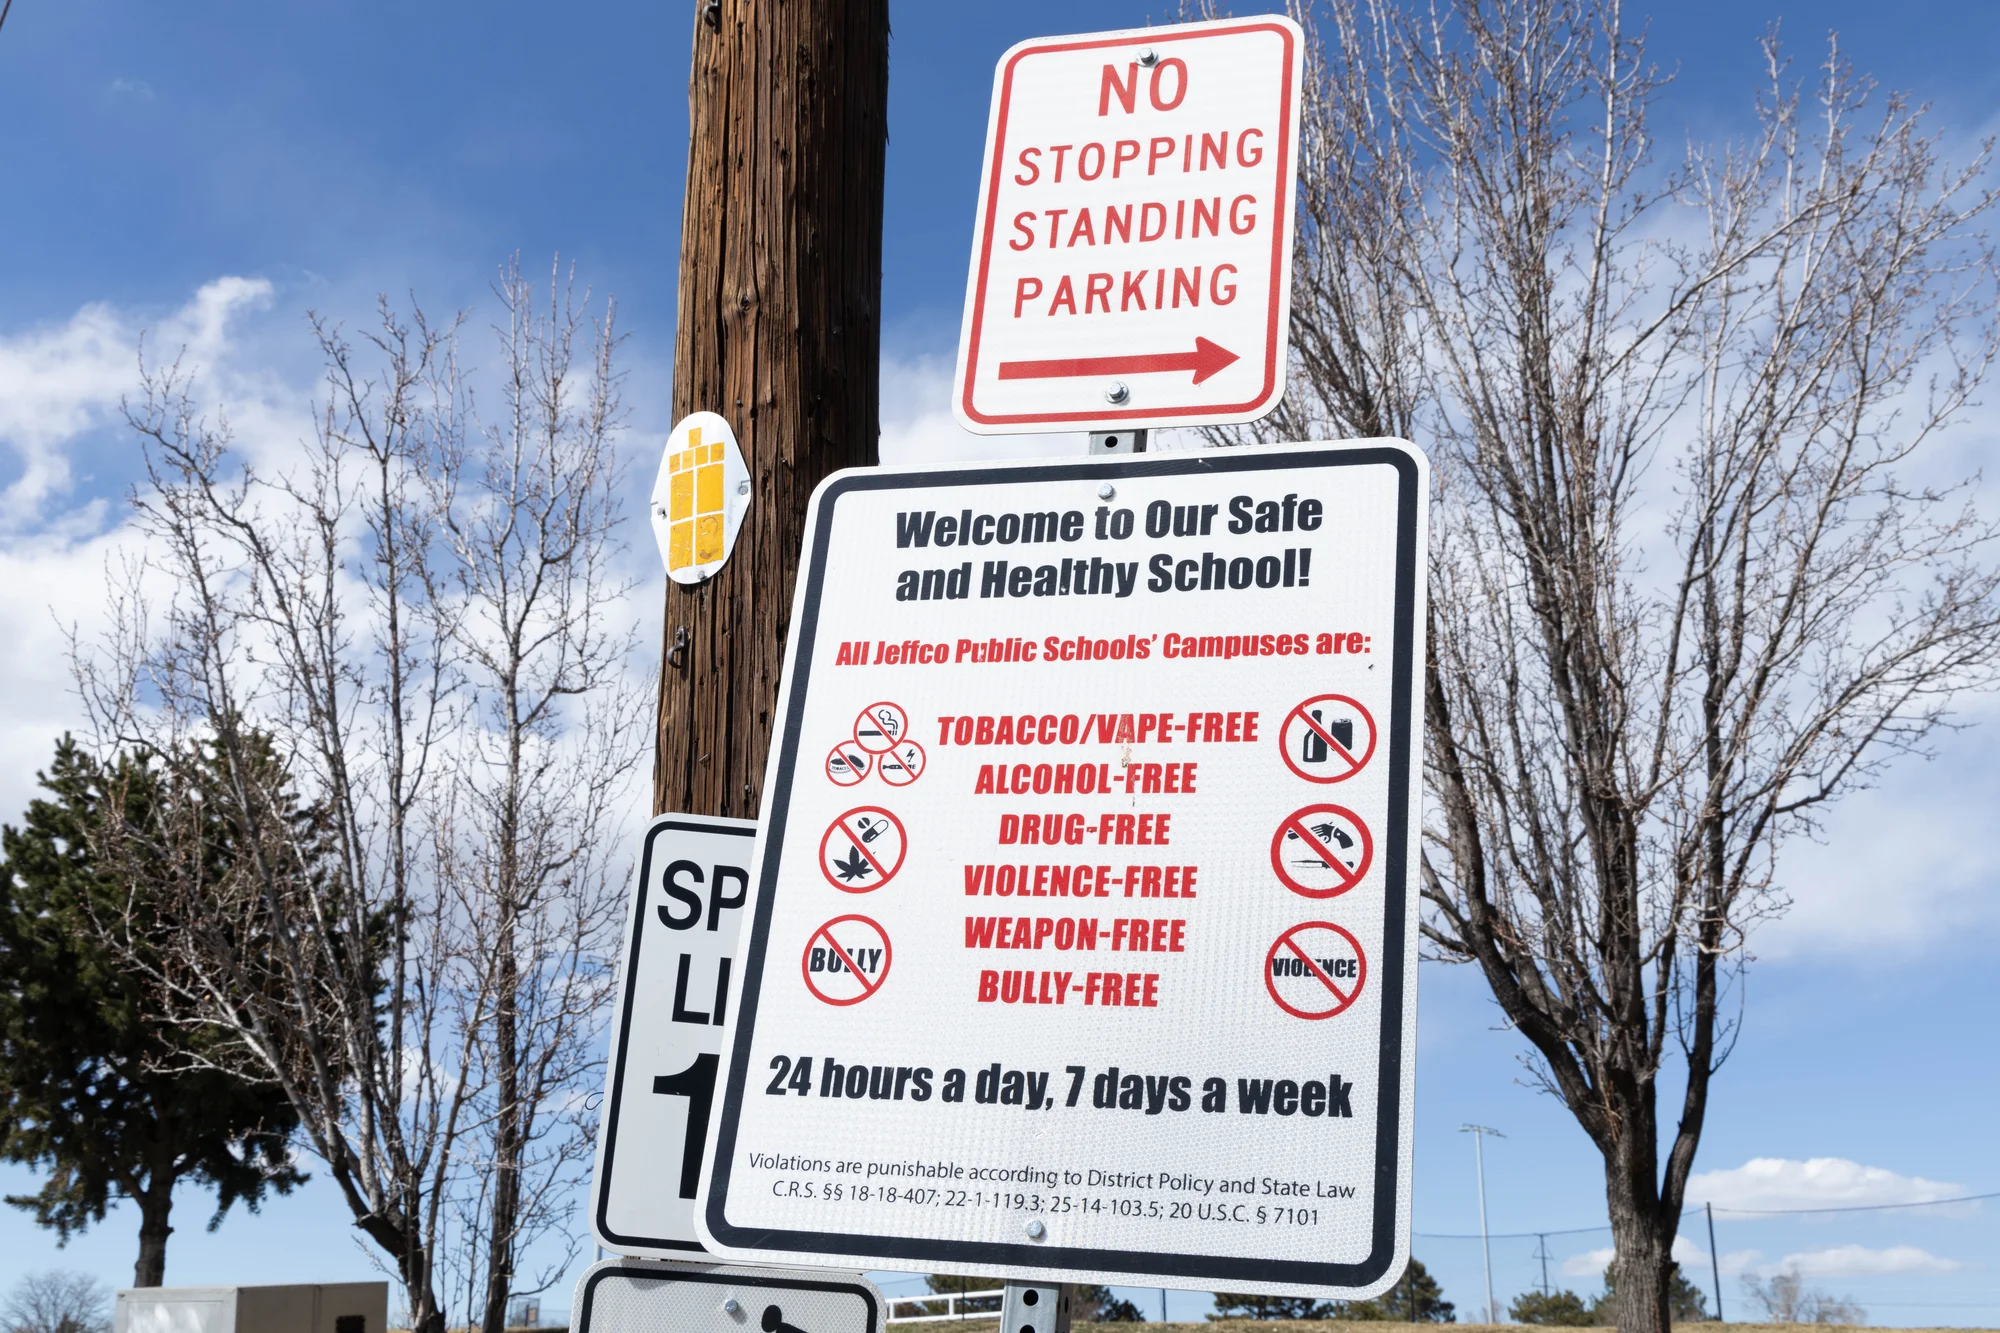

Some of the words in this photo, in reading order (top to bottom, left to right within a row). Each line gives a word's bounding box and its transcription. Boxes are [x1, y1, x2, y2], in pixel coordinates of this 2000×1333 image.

[1098, 58, 1188, 116] NO
[1015, 128, 1263, 186] STOPPING
[1009, 194, 1256, 251] STANDING
[1014, 264, 1237, 318] PARKING
[897, 510, 1084, 548] Welcome
[1095, 507, 1134, 539] to
[1146, 500, 1218, 538] Our
[1229, 494, 1322, 534] Safe
[896, 563, 972, 601] and
[981, 557, 1138, 598] Healthy
[1148, 548, 1311, 592] School!
[836, 641, 870, 666] All
[874, 640, 949, 664] Jeffco
[955, 638, 1037, 663] Public
[1163, 633, 1309, 660] Campuses
[1316, 632, 1371, 654] are:
[938, 712, 1259, 746] TOBACCO/VAPE-FREE
[974, 763, 1197, 794] ALCOHOL-FREE
[999, 814, 1170, 845] DRUG-FREE
[964, 864, 1198, 898] VIOLENCE-FREE
[965, 917, 1186, 952] WEAPON-FREE
[978, 970, 1159, 1007] BULLY-FREE
[766, 1055, 812, 1096] 24
[820, 1058, 933, 1101] hours
[942, 1069, 965, 1102] a
[975, 1063, 1053, 1110] day,
[1066, 1066, 1085, 1107] 7
[1093, 1067, 1191, 1115] days
[1202, 1077, 1226, 1113] a
[1238, 1074, 1352, 1117] week
[750, 1153, 830, 1172] Violations
[836, 1162, 862, 1173] are
[867, 1161, 963, 1179] punishable
[969, 1166, 1057, 1188] according
[1064, 1170, 1081, 1185] to
[1088, 1170, 1153, 1189] District
[1159, 1173, 1214, 1196] Policy
[1220, 1177, 1255, 1194] and
[1262, 1178, 1310, 1196] State
[1317, 1181, 1355, 1198] Law
[773, 1181, 817, 1198] C.R.S.
[824, 1183, 842, 1200] §§
[851, 1186, 941, 1207] 18-18-407;
[945, 1190, 1044, 1213] 22-1-119.3;
[1050, 1196, 1163, 1219] 25-14-103.5;
[1170, 1202, 1192, 1219] 20
[1199, 1203, 1249, 1222] U.S.C.
[1257, 1206, 1266, 1224] §
[1274, 1208, 1317, 1225] 7101
